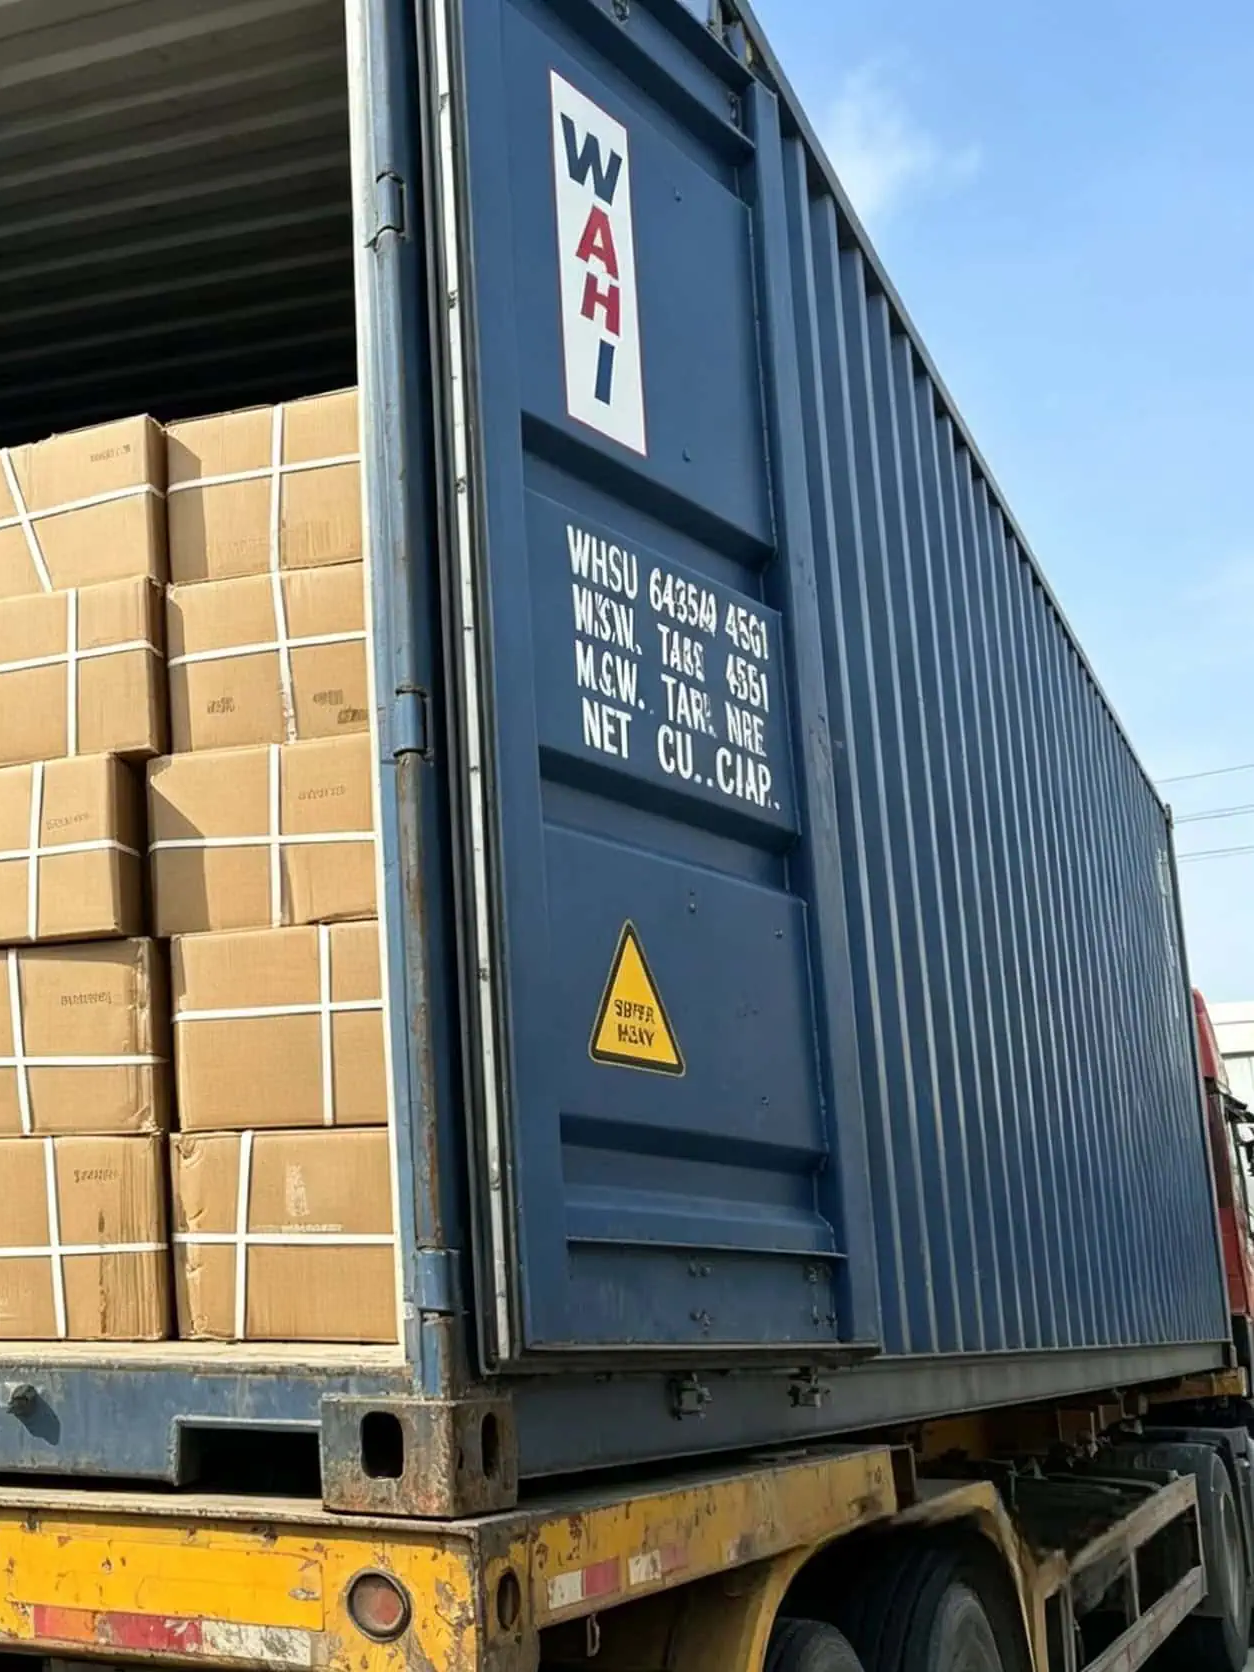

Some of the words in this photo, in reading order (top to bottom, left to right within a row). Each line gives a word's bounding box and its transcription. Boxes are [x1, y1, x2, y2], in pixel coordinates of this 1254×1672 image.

[560, 111, 624, 407] WAHI
[566, 524, 639, 601] WHSU
[582, 697, 633, 760] NET
